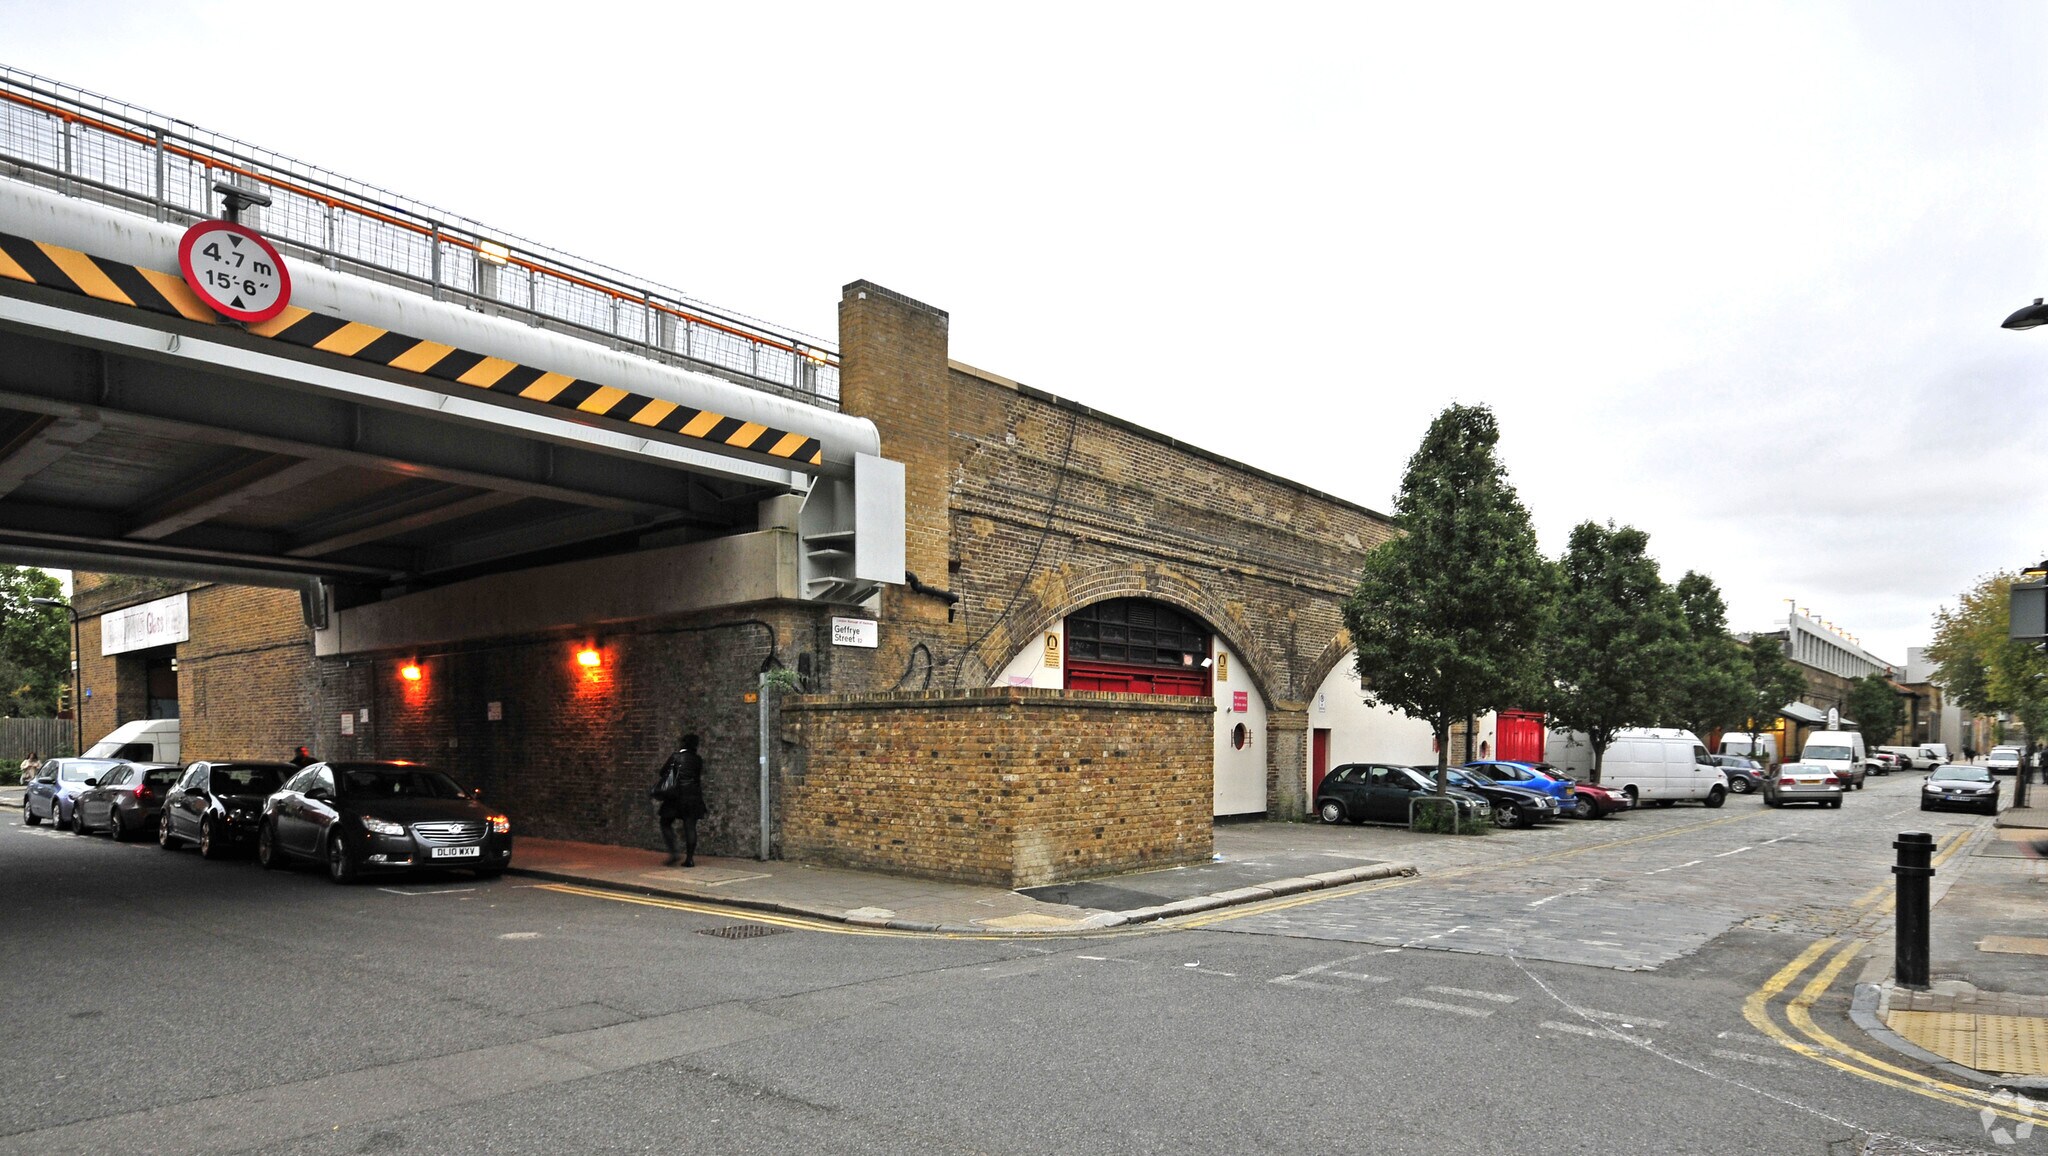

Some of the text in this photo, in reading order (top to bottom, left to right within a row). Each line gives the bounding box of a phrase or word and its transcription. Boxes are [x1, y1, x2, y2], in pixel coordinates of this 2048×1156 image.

[203, 242, 272, 276] 4.7 m
[834, 625, 860, 635] Geffrye
[834, 634, 855, 643] Street
[437, 847, 475, 856] DL10 WXV
